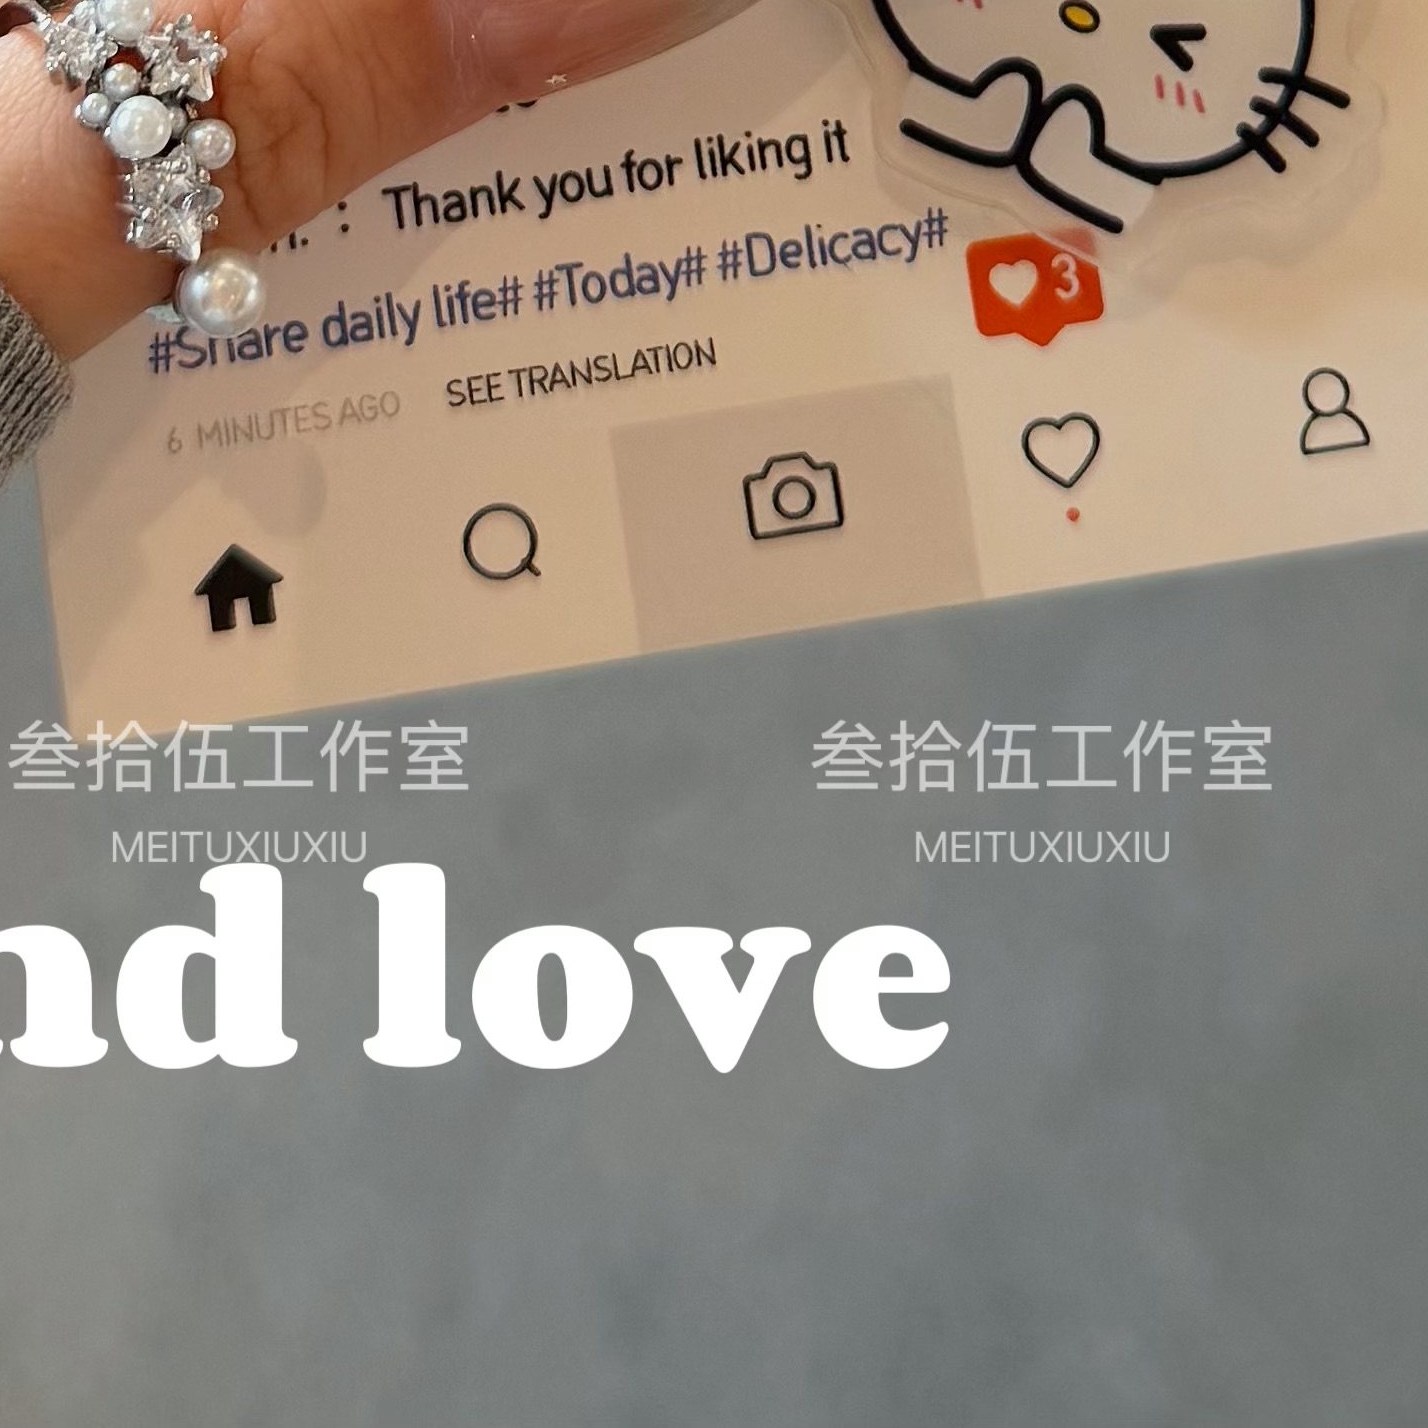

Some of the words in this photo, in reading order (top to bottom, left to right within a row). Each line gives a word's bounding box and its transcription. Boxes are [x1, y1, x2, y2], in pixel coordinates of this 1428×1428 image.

[381, 170, 526, 230] Thank
[533, 166, 613, 219] you
[622, 148, 682, 195] for
[693, 131, 811, 180] liking
[822, 119, 850, 164] it
[322, 290, 422, 346] daily
[432, 274, 524, 328] life#
[532, 246, 707, 312] #Today#
[716, 207, 948, 282] #Delicacy#
[1049, 254, 1080, 300] 3
[446, 372, 504, 408] SEE
[507, 337, 717, 399] TRANSLATION
[196, 402, 332, 450] MINUTES
[338, 390, 401, 425] AGO
